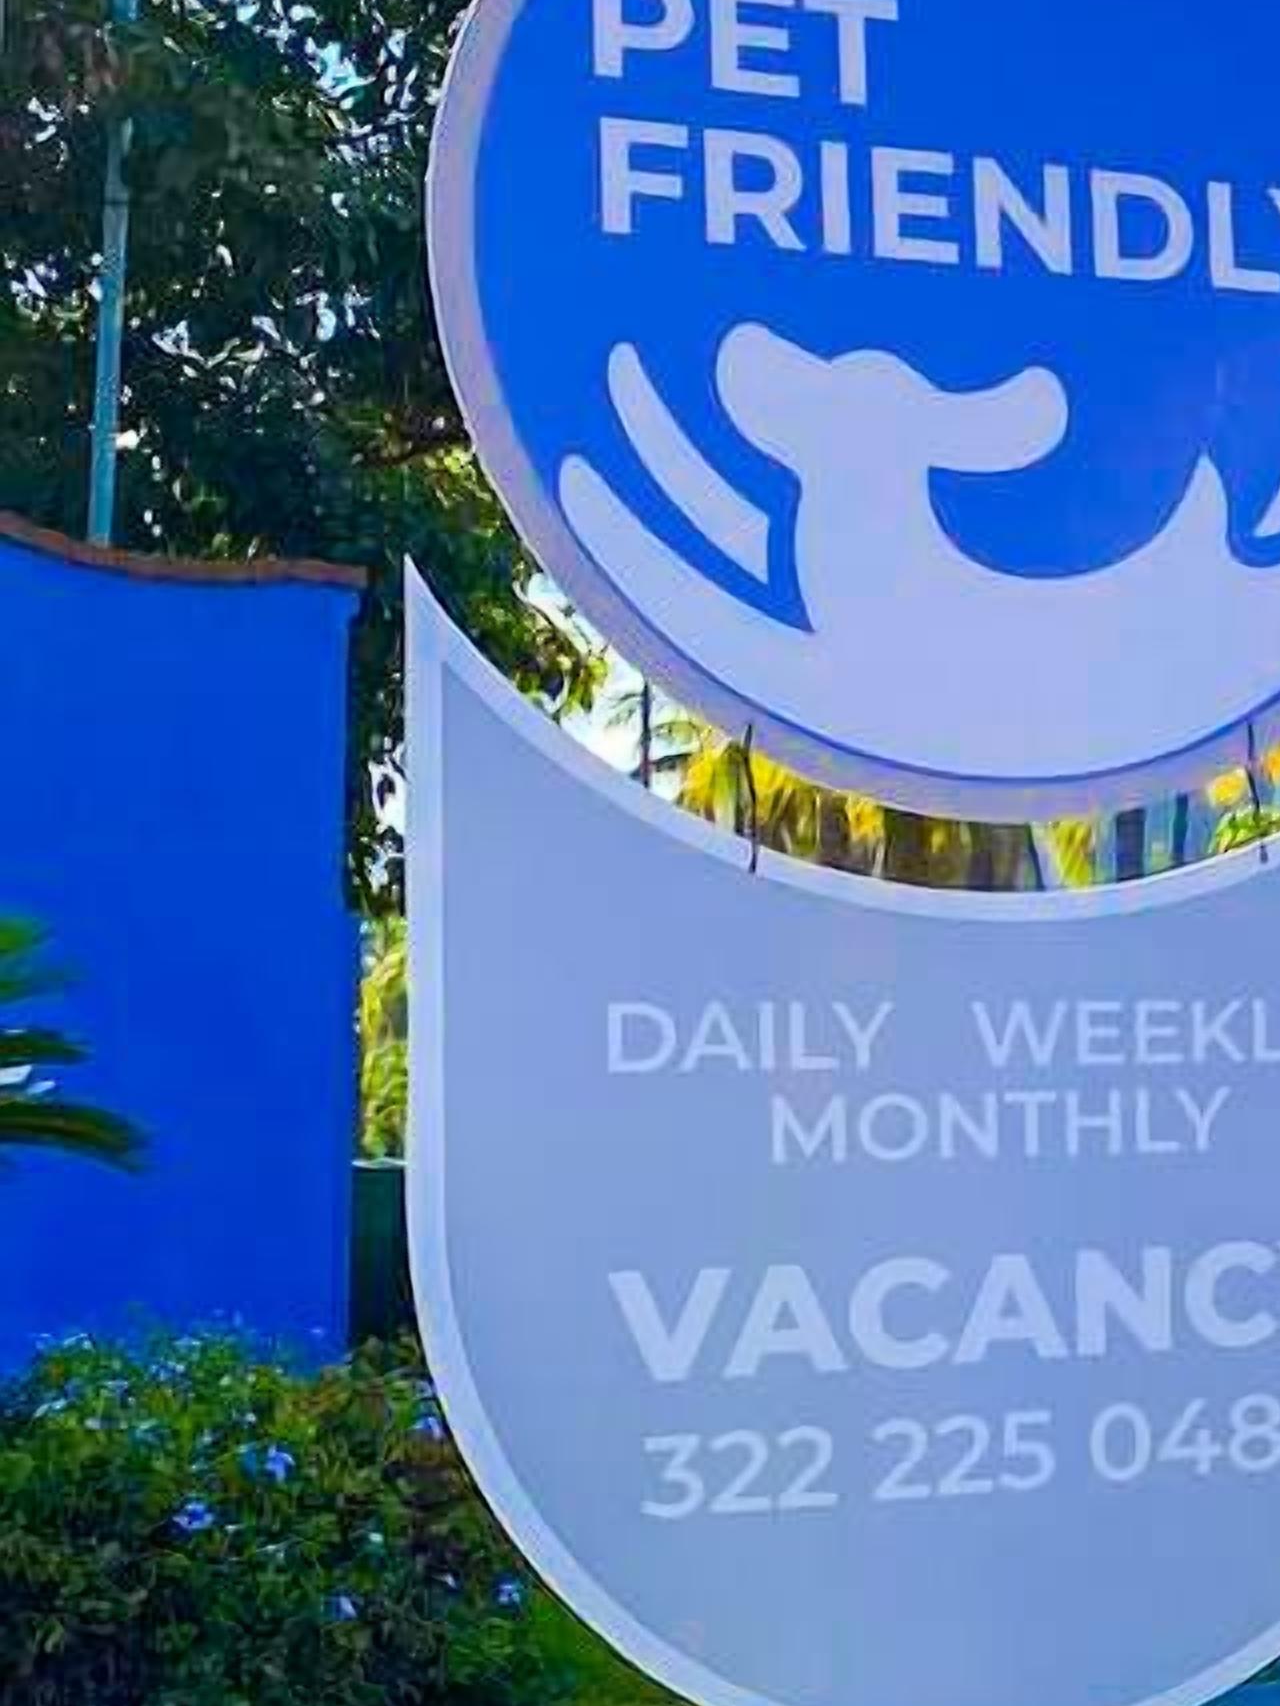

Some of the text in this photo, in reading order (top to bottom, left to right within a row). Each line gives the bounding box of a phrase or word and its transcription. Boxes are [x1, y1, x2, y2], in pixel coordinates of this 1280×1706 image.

[606, 1000, 894, 1074] DAILY
[771, 1087, 1231, 1162] MONTHLY
[641, 1427, 838, 1519] 322
[872, 1411, 1054, 1501] 225
